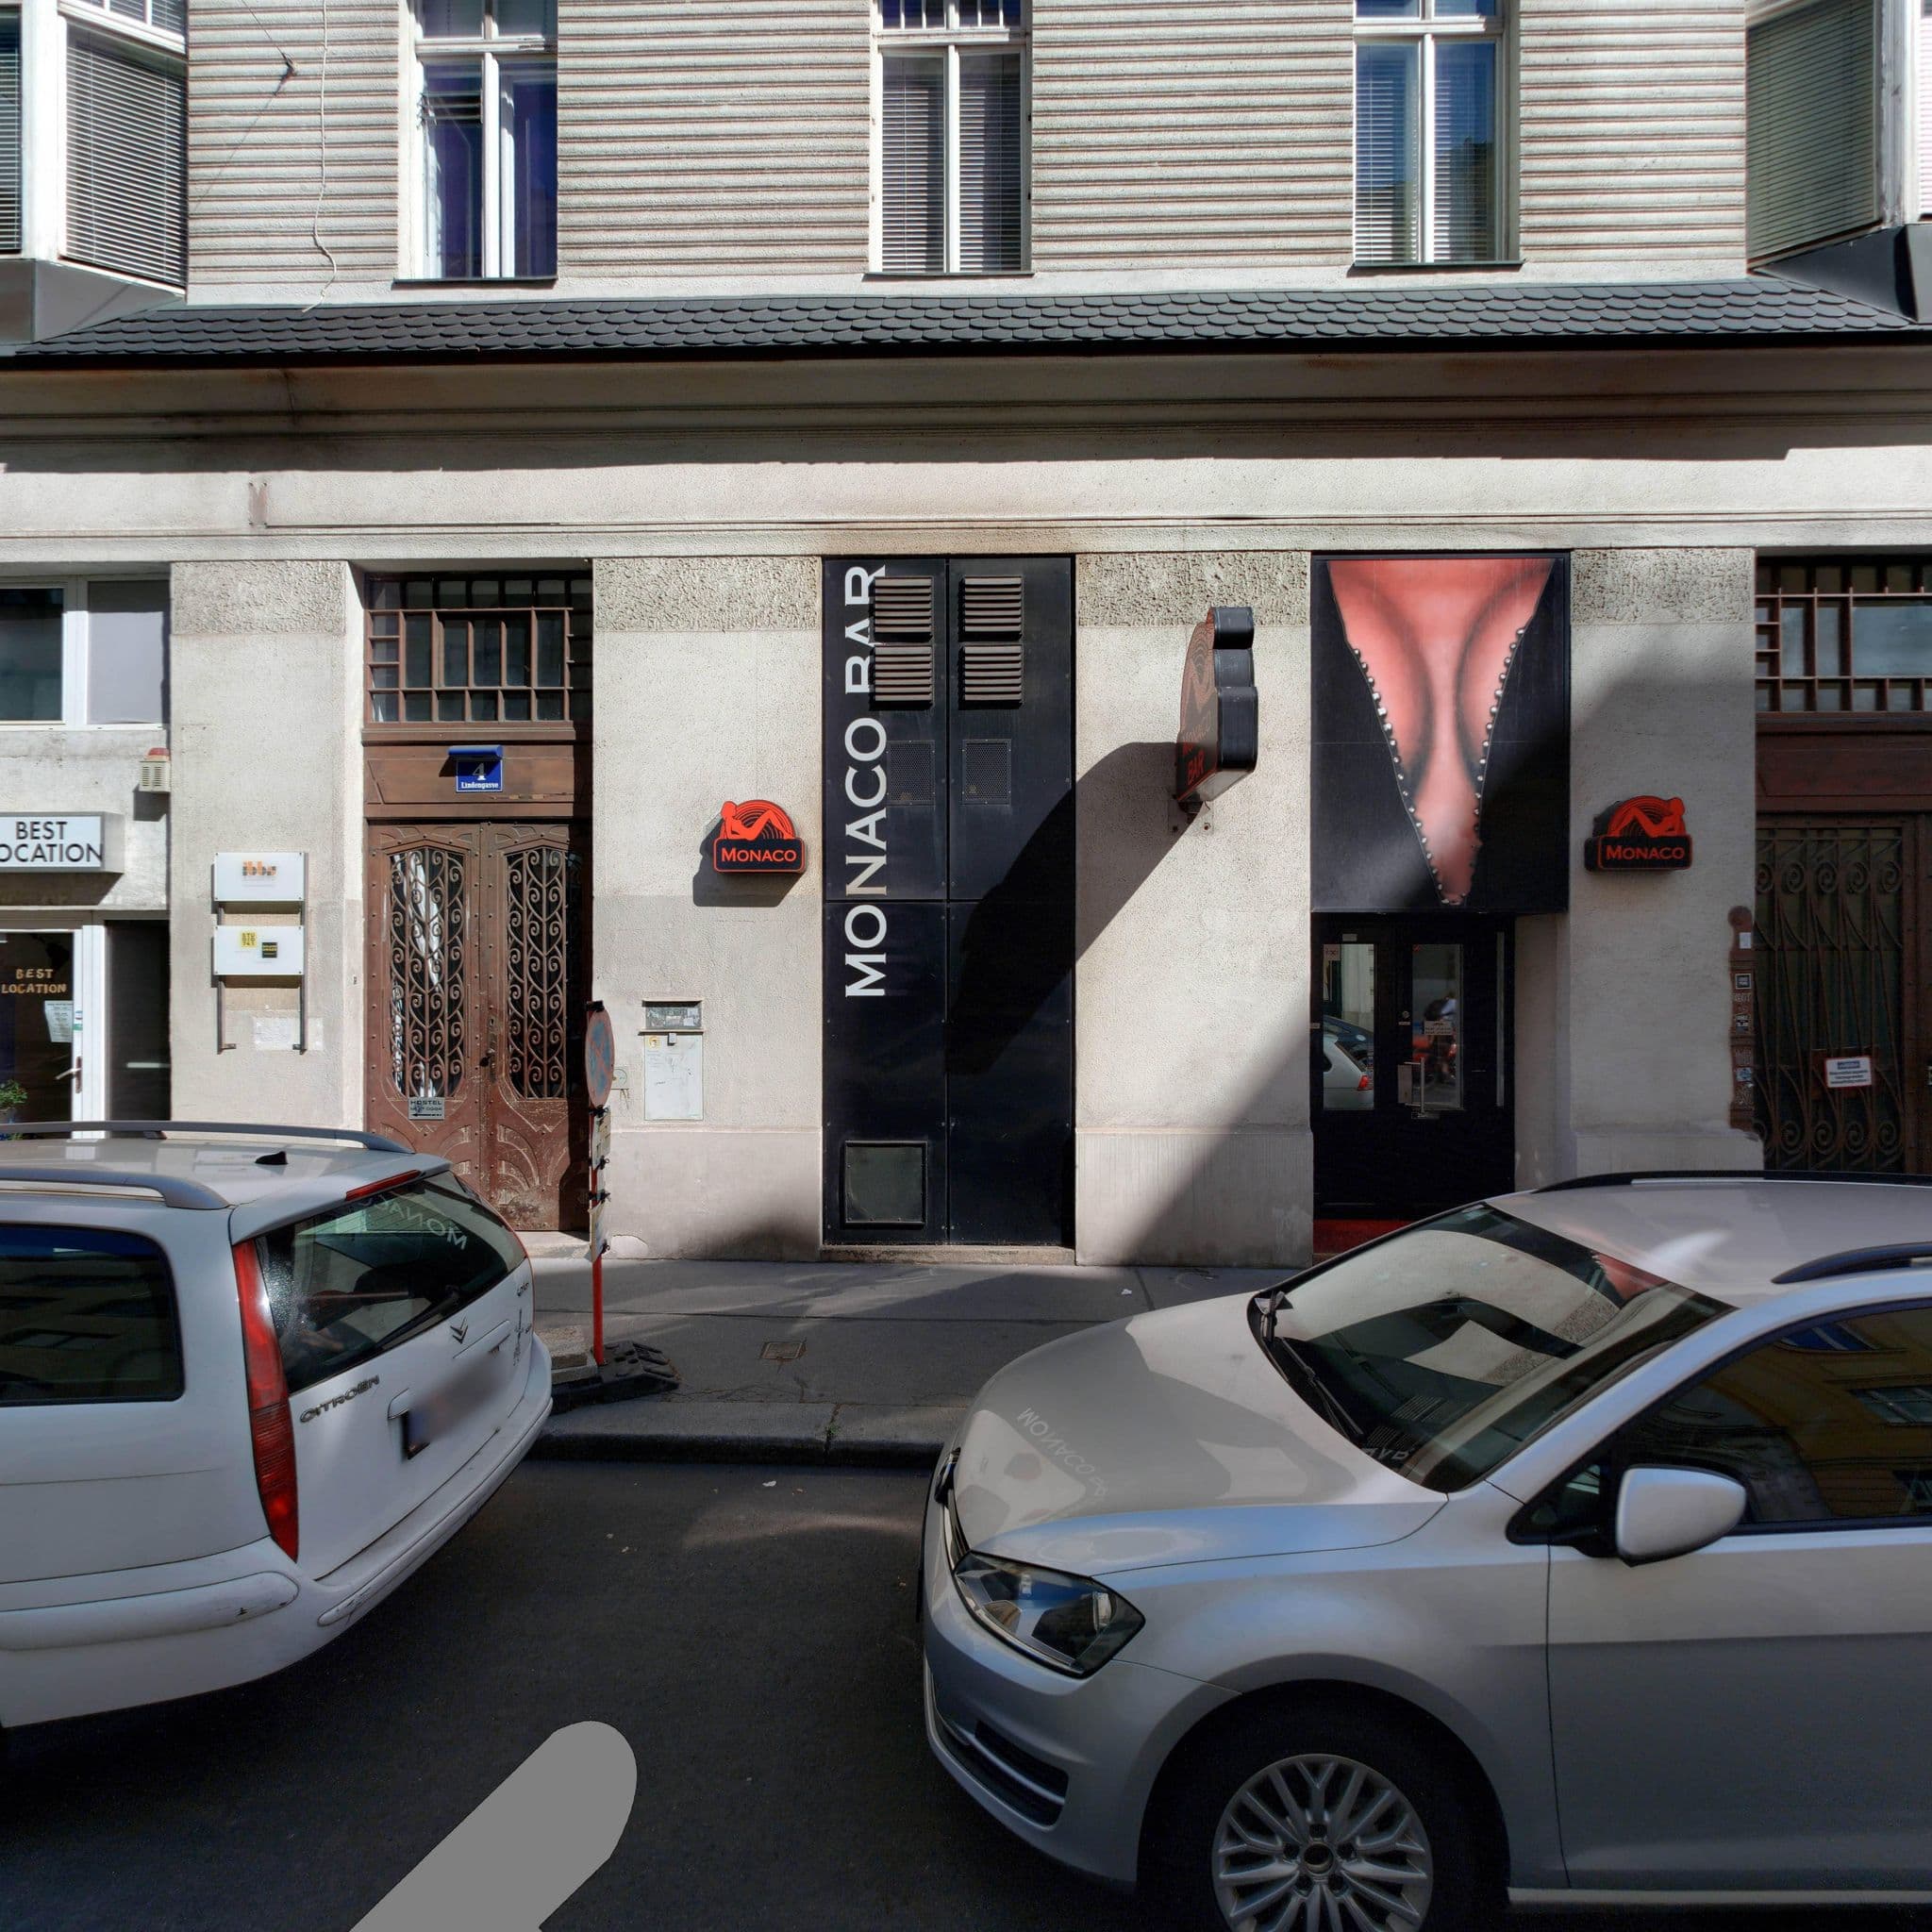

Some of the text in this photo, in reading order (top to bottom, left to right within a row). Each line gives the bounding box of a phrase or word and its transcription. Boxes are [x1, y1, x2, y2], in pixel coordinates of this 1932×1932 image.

[473, 762, 487, 781] 4
[15, 821, 68, 840] BEST
[721, 847, 797, 862] MONACO
[844, 717, 888, 998] MONACO
[15, 968, 54, 980] BEST
[1, 983, 67, 994] LOCATION
